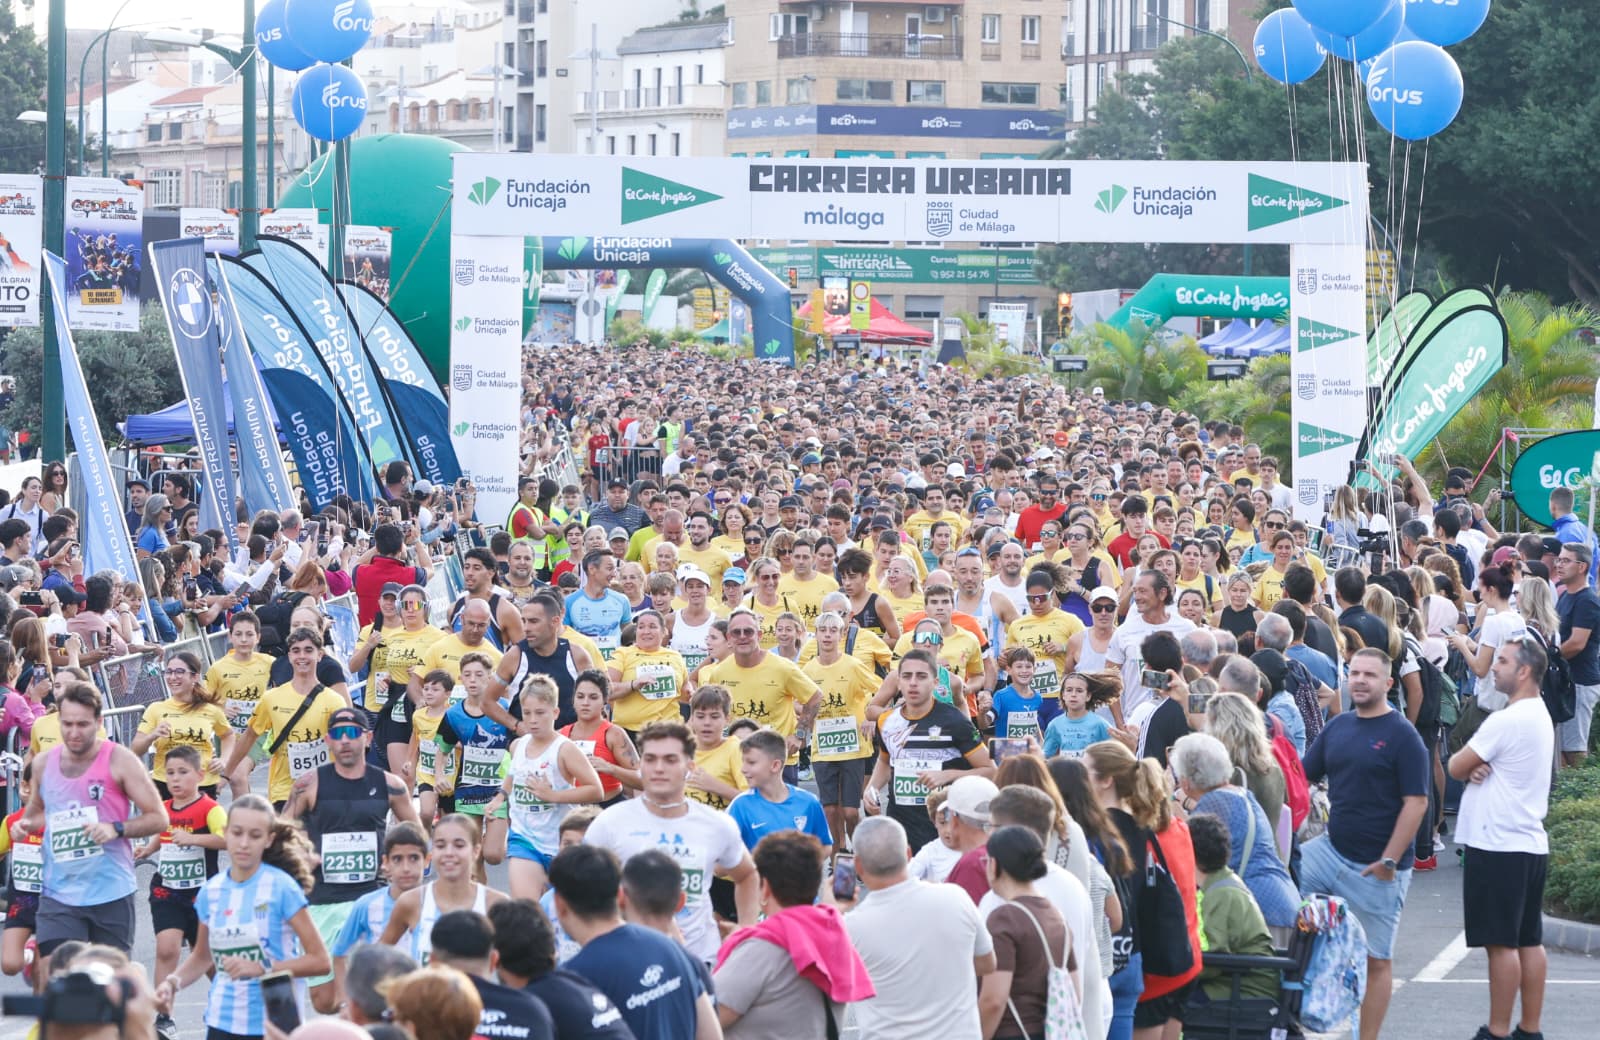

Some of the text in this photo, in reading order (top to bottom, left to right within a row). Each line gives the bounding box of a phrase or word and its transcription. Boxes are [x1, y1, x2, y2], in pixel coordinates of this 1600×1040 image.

[507, 179, 590, 194] Fundación
[749, 164, 1071, 195] CARRERA URBANA
[1132, 186, 1217, 201] Fundación
[507, 194, 566, 212] Unicaja
[1132, 202, 1193, 219] Unicaja
[959, 209, 999, 220] Ciudad
[959, 220, 1016, 233] de Málaga
[593, 249, 650, 264] Unicaja
[1175, 286, 1192, 304] El
[1193, 288, 1231, 305] Corte
[474, 317, 519, 326] Fundación
[474, 326, 507, 336] Unicaja
[472, 423, 517, 431] Fundación
[472, 431, 505, 441] Unicaja
[290, 411, 330, 506] Fundación
[819, 732, 856, 746] 20220
[293, 751, 328, 770] 8510
[161, 862, 203, 878] 23176
[326, 854, 375, 871] 22513
